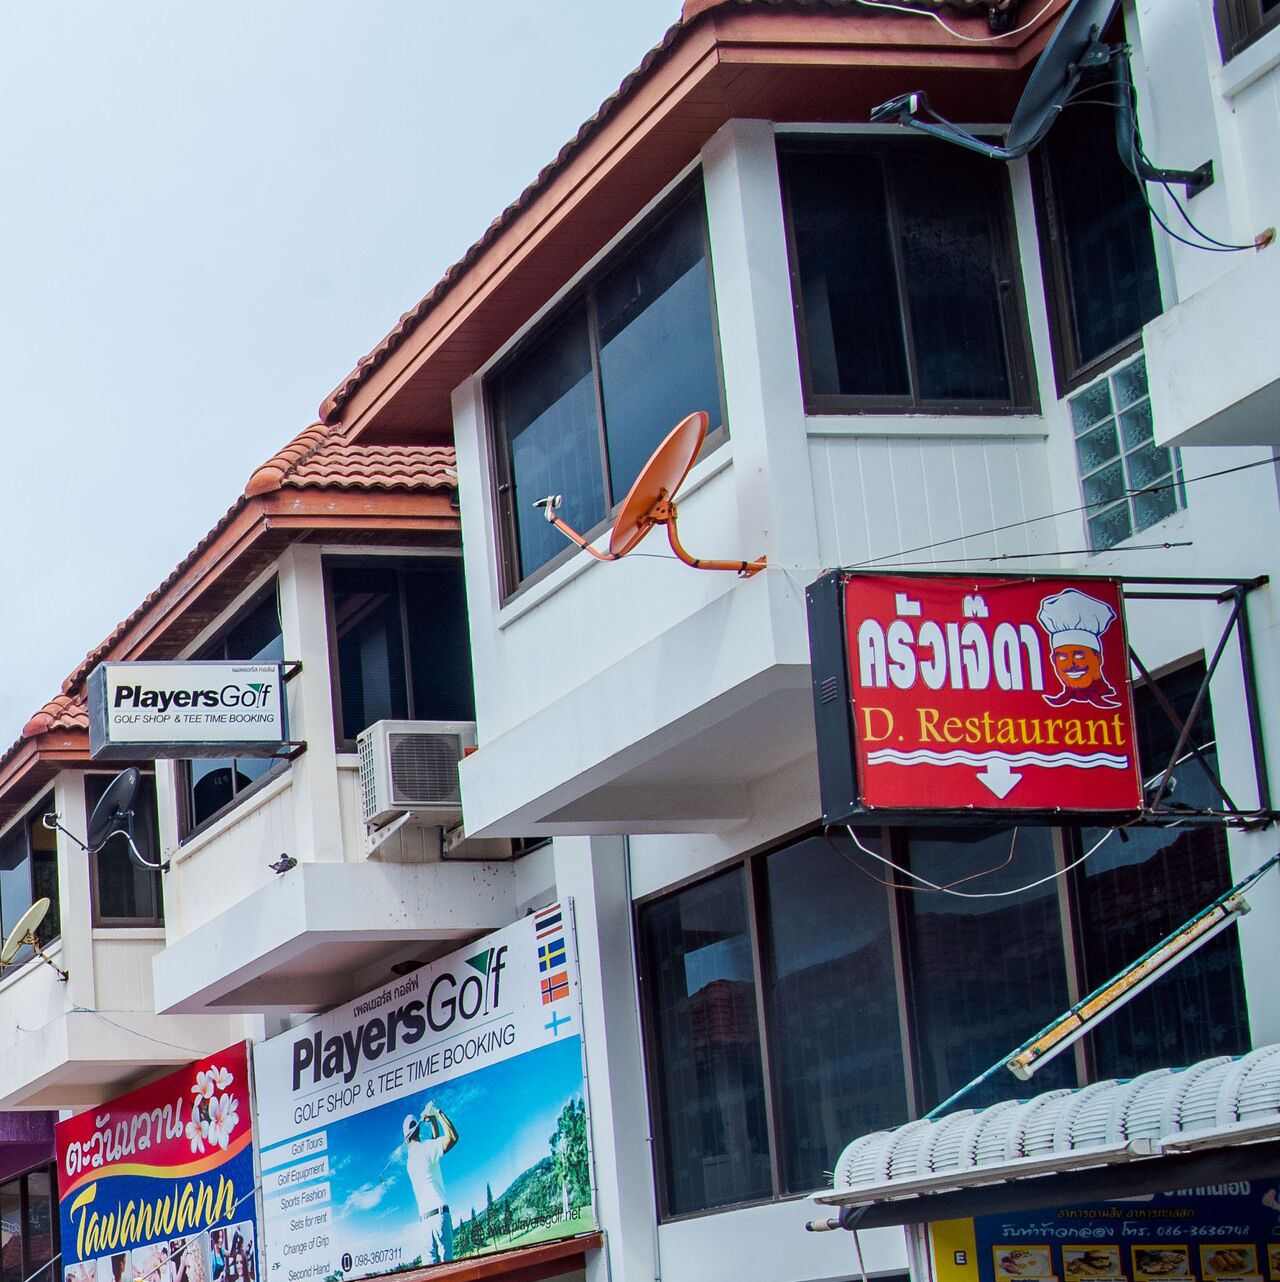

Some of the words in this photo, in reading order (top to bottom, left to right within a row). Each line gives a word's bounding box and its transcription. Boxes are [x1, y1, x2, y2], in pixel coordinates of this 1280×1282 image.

[857, 593, 1046, 691] ครัวเจ๊ดา
[113, 683, 273, 713] PlayersGolf
[114, 714, 141, 724] GOLF
[142, 714, 171, 724] SHOP
[174, 714, 181, 724] &
[183, 714, 202, 724] TEE
[204, 714, 227, 724] TIME
[229, 714, 274, 724] BOOKING
[861, 707, 904, 742] D.
[917, 708, 1126, 745] Restaurant
[292, 945, 509, 1092] PlayersGolf
[294, 1097, 325, 1125] GOLF
[326, 1083, 361, 1114] SHOP
[366, 1079, 376, 1098] &
[378, 1067, 404, 1094] TEE
[406, 1053, 440, 1083] TIME
[443, 1022, 516, 1070] BOOKING
[65, 1097, 184, 1177] ตะวันหวาน
[291, 1141, 305, 1156] Golf
[306, 1135, 325, 1152] Tours
[277, 1171, 291, 1187] Golf
[291, 1162, 326, 1182] Equipment
[280, 1194, 301, 1212] Sports
[301, 1187, 327, 1205] Fashion
[70, 1174, 239, 1262] Tawanwann
[289, 1216, 305, 1232] Sets
[305, 1214, 314, 1228] for
[314, 1212, 328, 1226] rent
[1157, 1225, 1250, 1237] 086-3636748
[283, 1240, 308, 1257] Change
[309, 1239, 316, 1251] of
[316, 1234, 330, 1251] Grip
[354, 1246, 403, 1268] 098-3607311
[288, 1263, 313, 1282] Second
[313, 1261, 331, 1277] Hand
